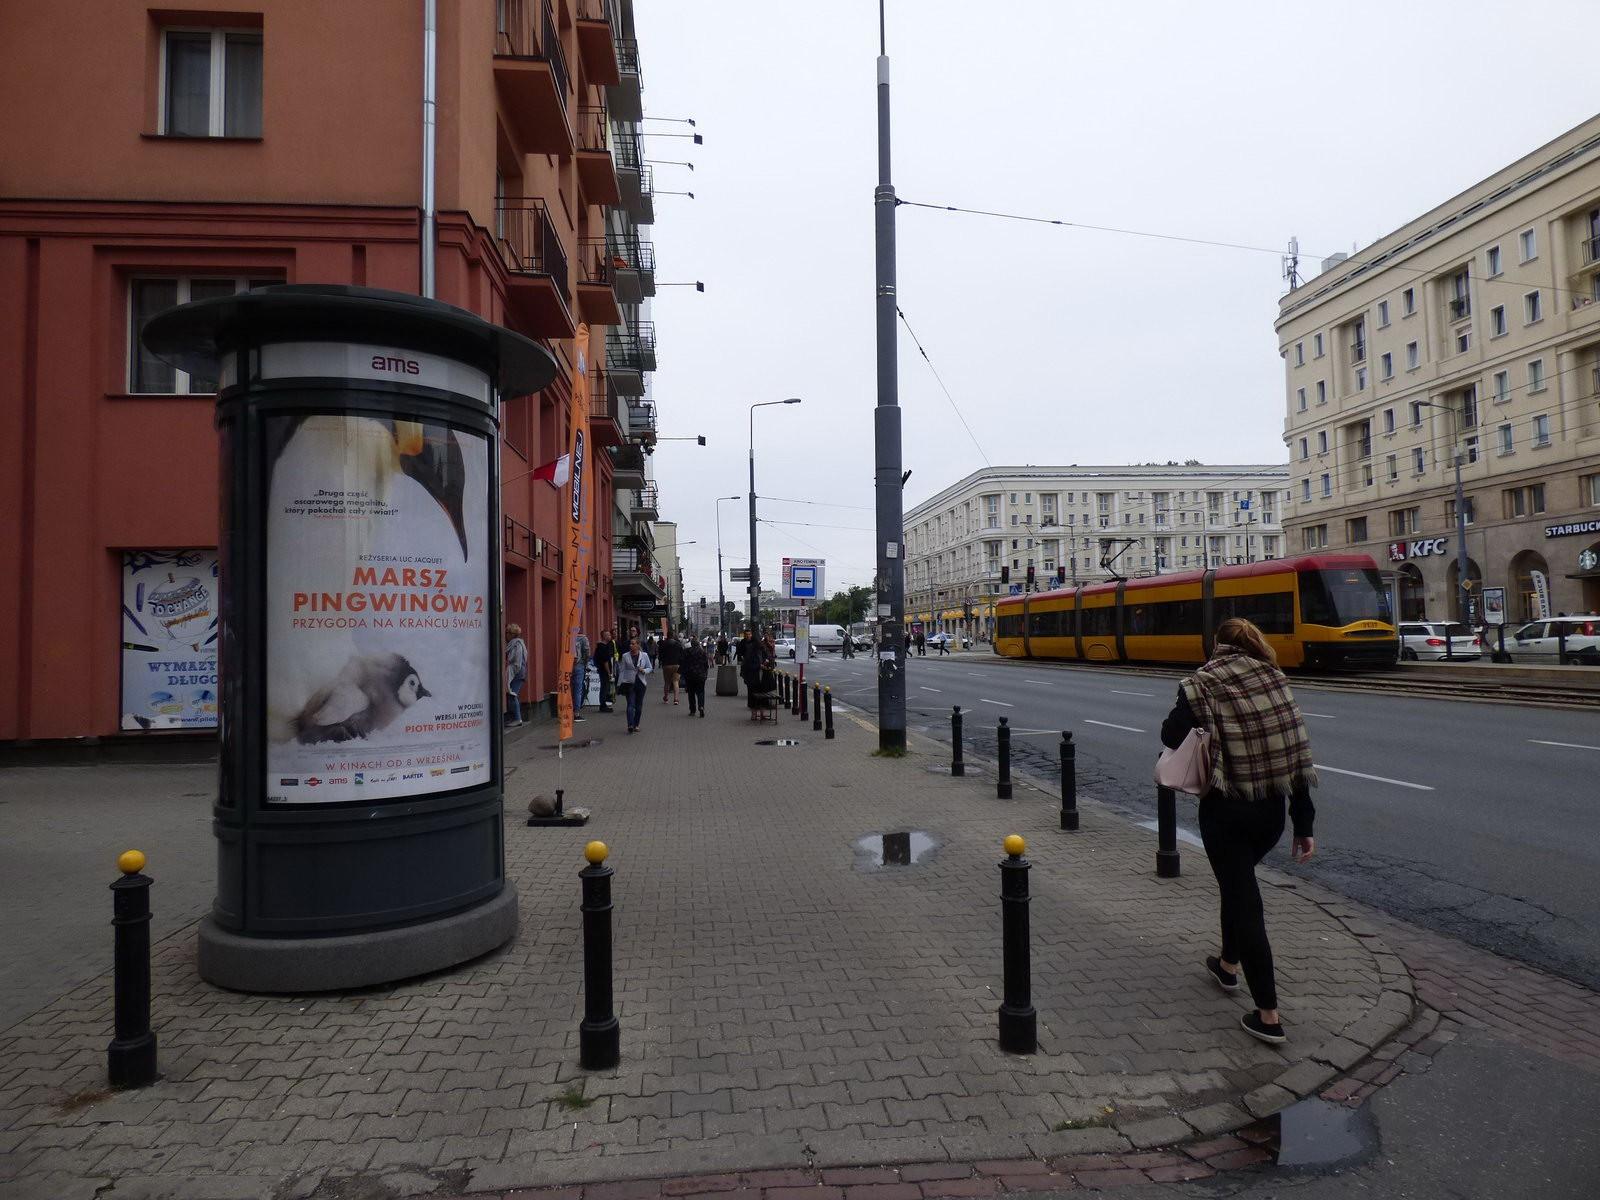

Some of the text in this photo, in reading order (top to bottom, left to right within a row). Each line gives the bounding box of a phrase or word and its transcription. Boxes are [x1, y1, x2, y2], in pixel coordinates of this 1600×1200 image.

[371, 355, 420, 375] ams
[571, 430, 583, 521] MOBILNEJ
[294, 498, 344, 507] oscarowego
[284, 506, 305, 516] który
[307, 506, 346, 516] pokochał
[348, 508, 367, 517] cały
[1409, 538, 1445, 557] KFC
[359, 554, 397, 562] REŻYSERIA
[352, 567, 448, 588] MARSZ
[293, 589, 484, 614] PINGWINÓW 2
[293, 615, 481, 629] PRZYGODA NA KRAŃCU ŚWIATA
[405, 724, 434, 734] PIOTR
[326, 762, 336, 770] W
[340, 760, 383, 771] KINACH
[386, 760, 402, 768] OD
[416, 753, 461, 765] WRZEŚNIA
[328, 777, 348, 785] ams
[402, 772, 424, 780] BARTEK
